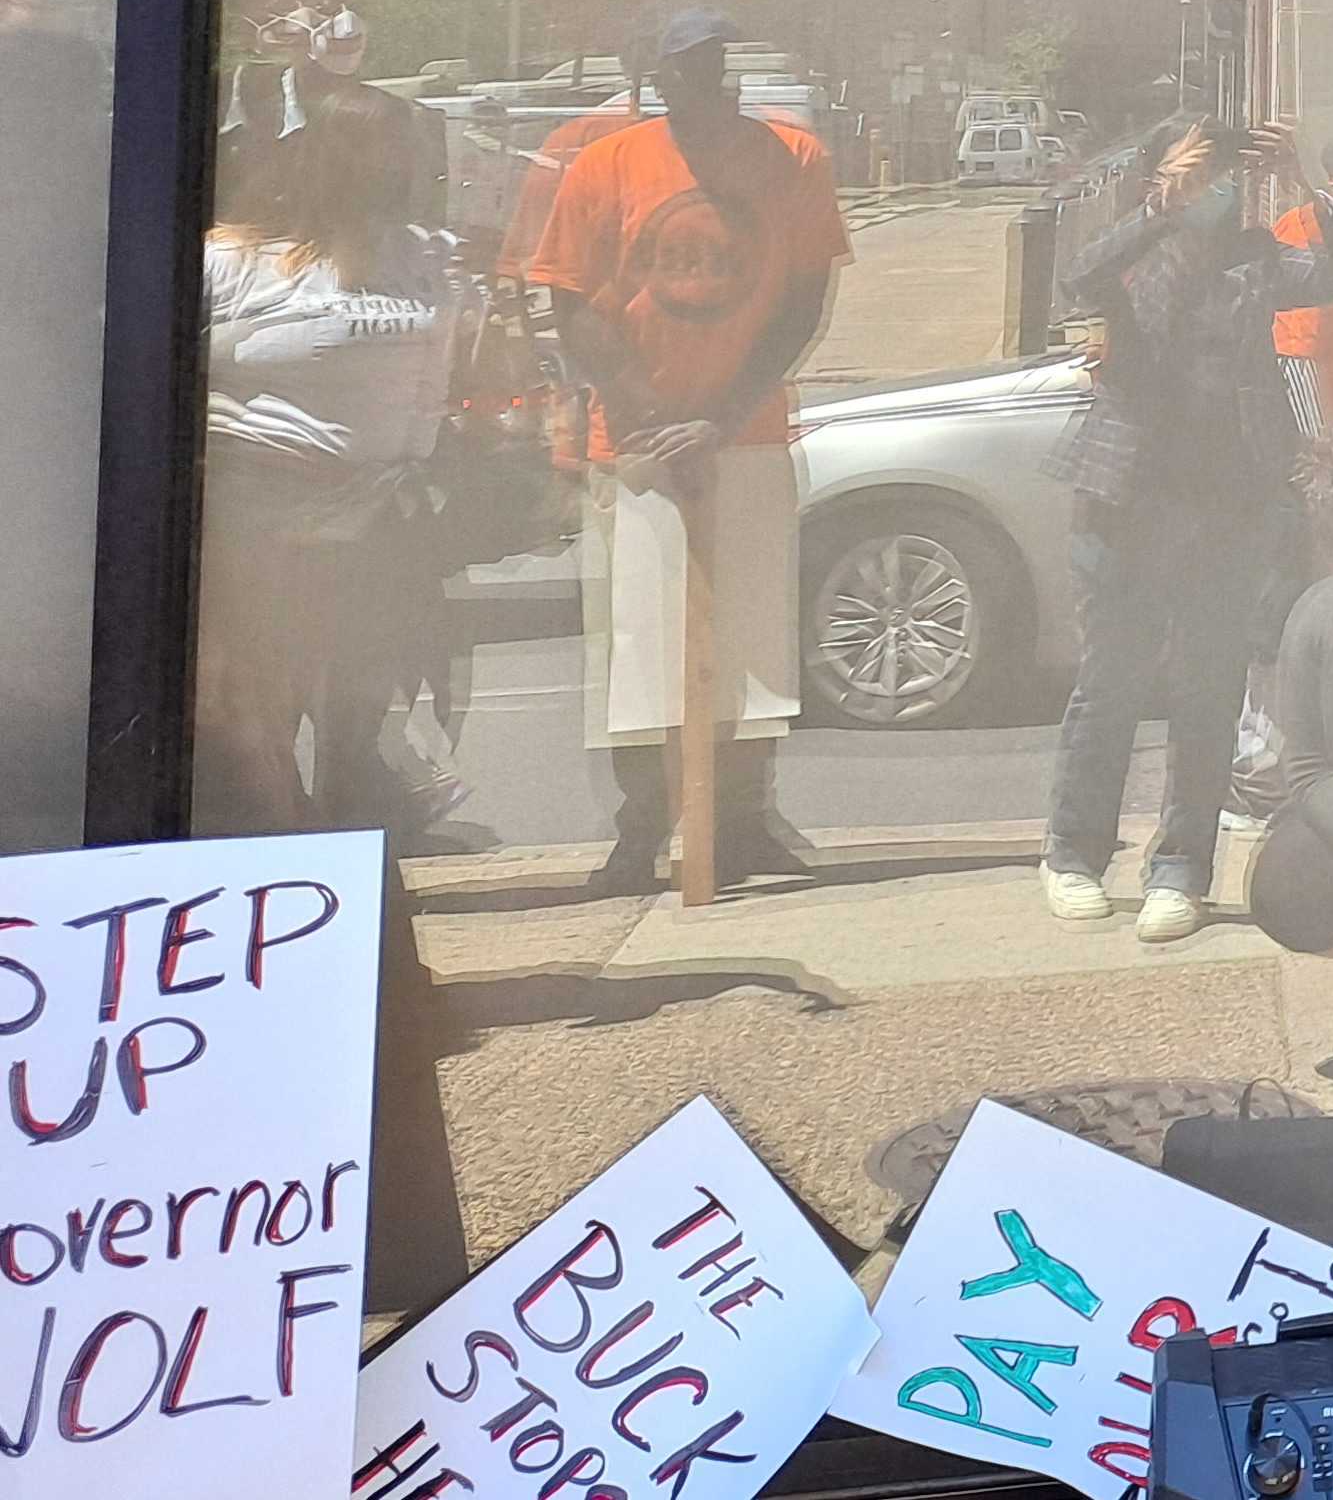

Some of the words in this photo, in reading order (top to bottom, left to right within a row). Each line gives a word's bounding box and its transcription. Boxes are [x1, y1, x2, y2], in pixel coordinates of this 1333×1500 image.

[0, 880, 340, 1035] STEP
[8, 1017, 207, 1146] UP
[652, 1185, 784, 1341] THE
[897, 1208, 1103, 1448] PAY
[513, 1219, 758, 1500] BUCK
